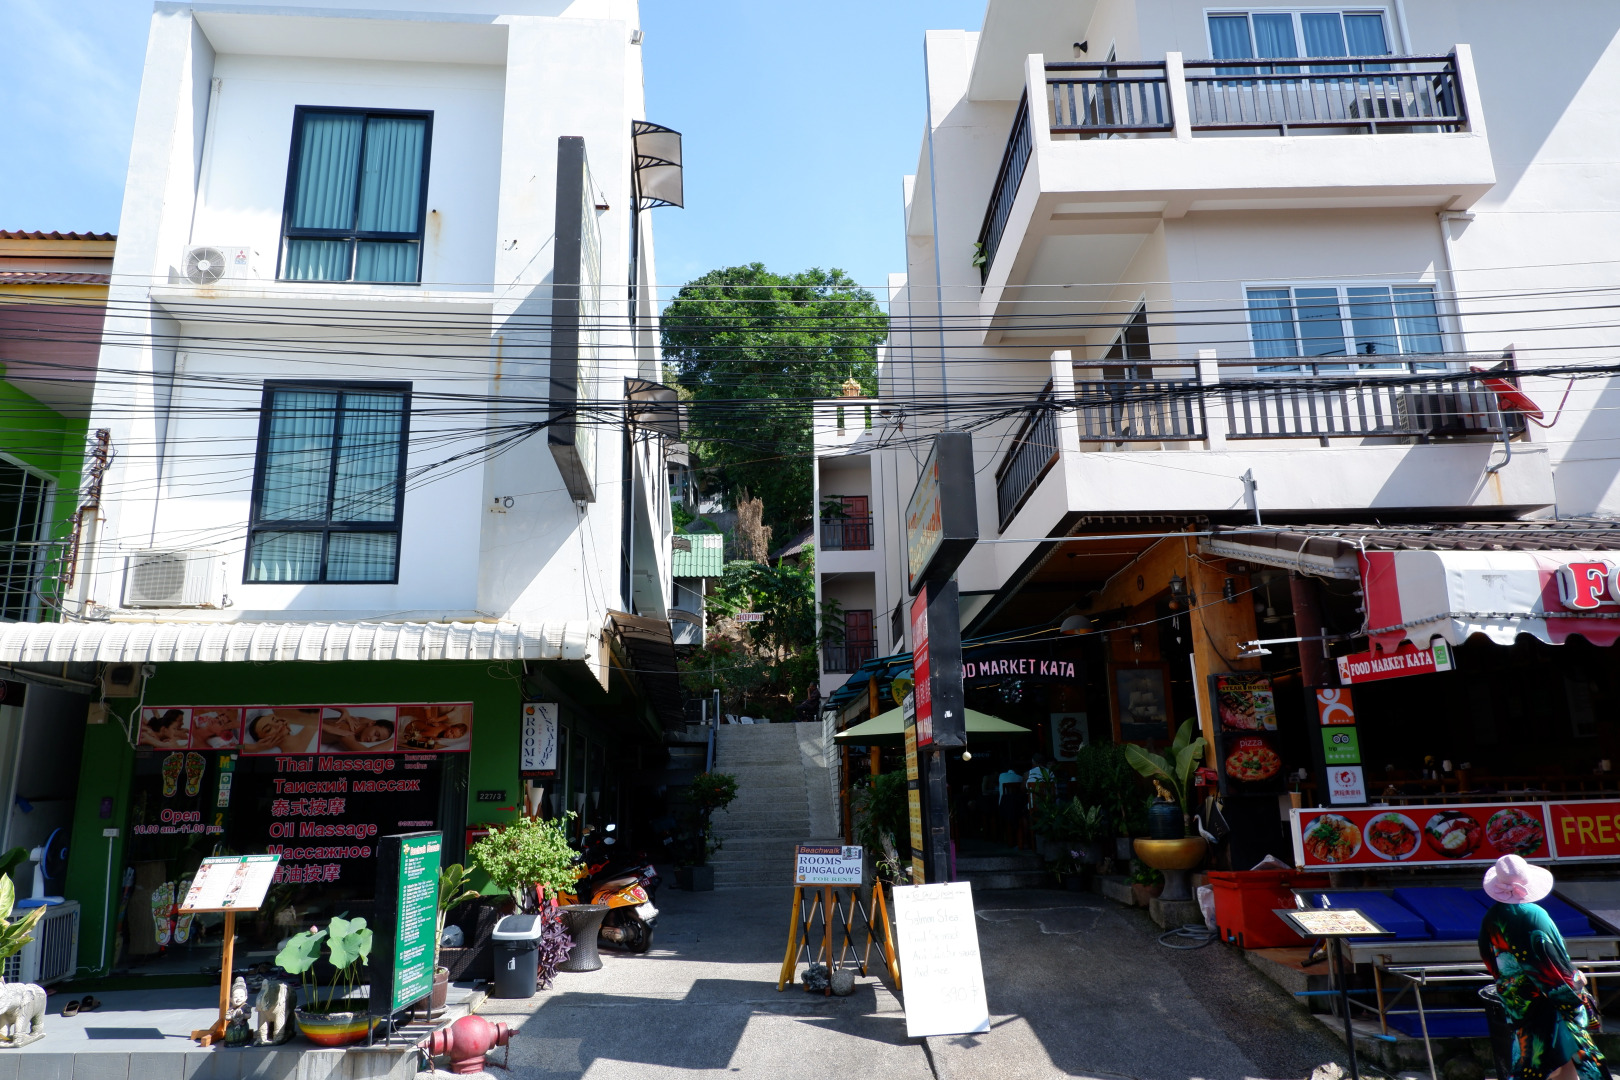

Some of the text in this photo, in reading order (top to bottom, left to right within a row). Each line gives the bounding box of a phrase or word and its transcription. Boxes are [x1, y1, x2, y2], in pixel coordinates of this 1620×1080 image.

[1559, 562, 1620, 610] F
[980, 659, 1036, 677] MARKET
[1040, 660, 1075, 678] KATA
[1350, 651, 1433, 677] FOOD MARKET KATA
[524, 717, 536, 767] ROOMS
[1239, 738, 1263, 748] pizza
[275, 757, 314, 772] Thai
[318, 757, 395, 774] Massage
[352, 779, 421, 793] массаж
[271, 797, 346, 816] 泰式按摩
[161, 808, 200, 824] Open
[133, 824, 159, 834] 10.00
[205, 824, 225, 835] pm.
[269, 822, 295, 838] Oil
[299, 822, 378, 839] Massage
[268, 844, 372, 860] Массажное
[800, 846, 840, 854] Beachwalk
[800, 856, 842, 865] ROOMS
[798, 866, 861, 875] BUNGALOWS
